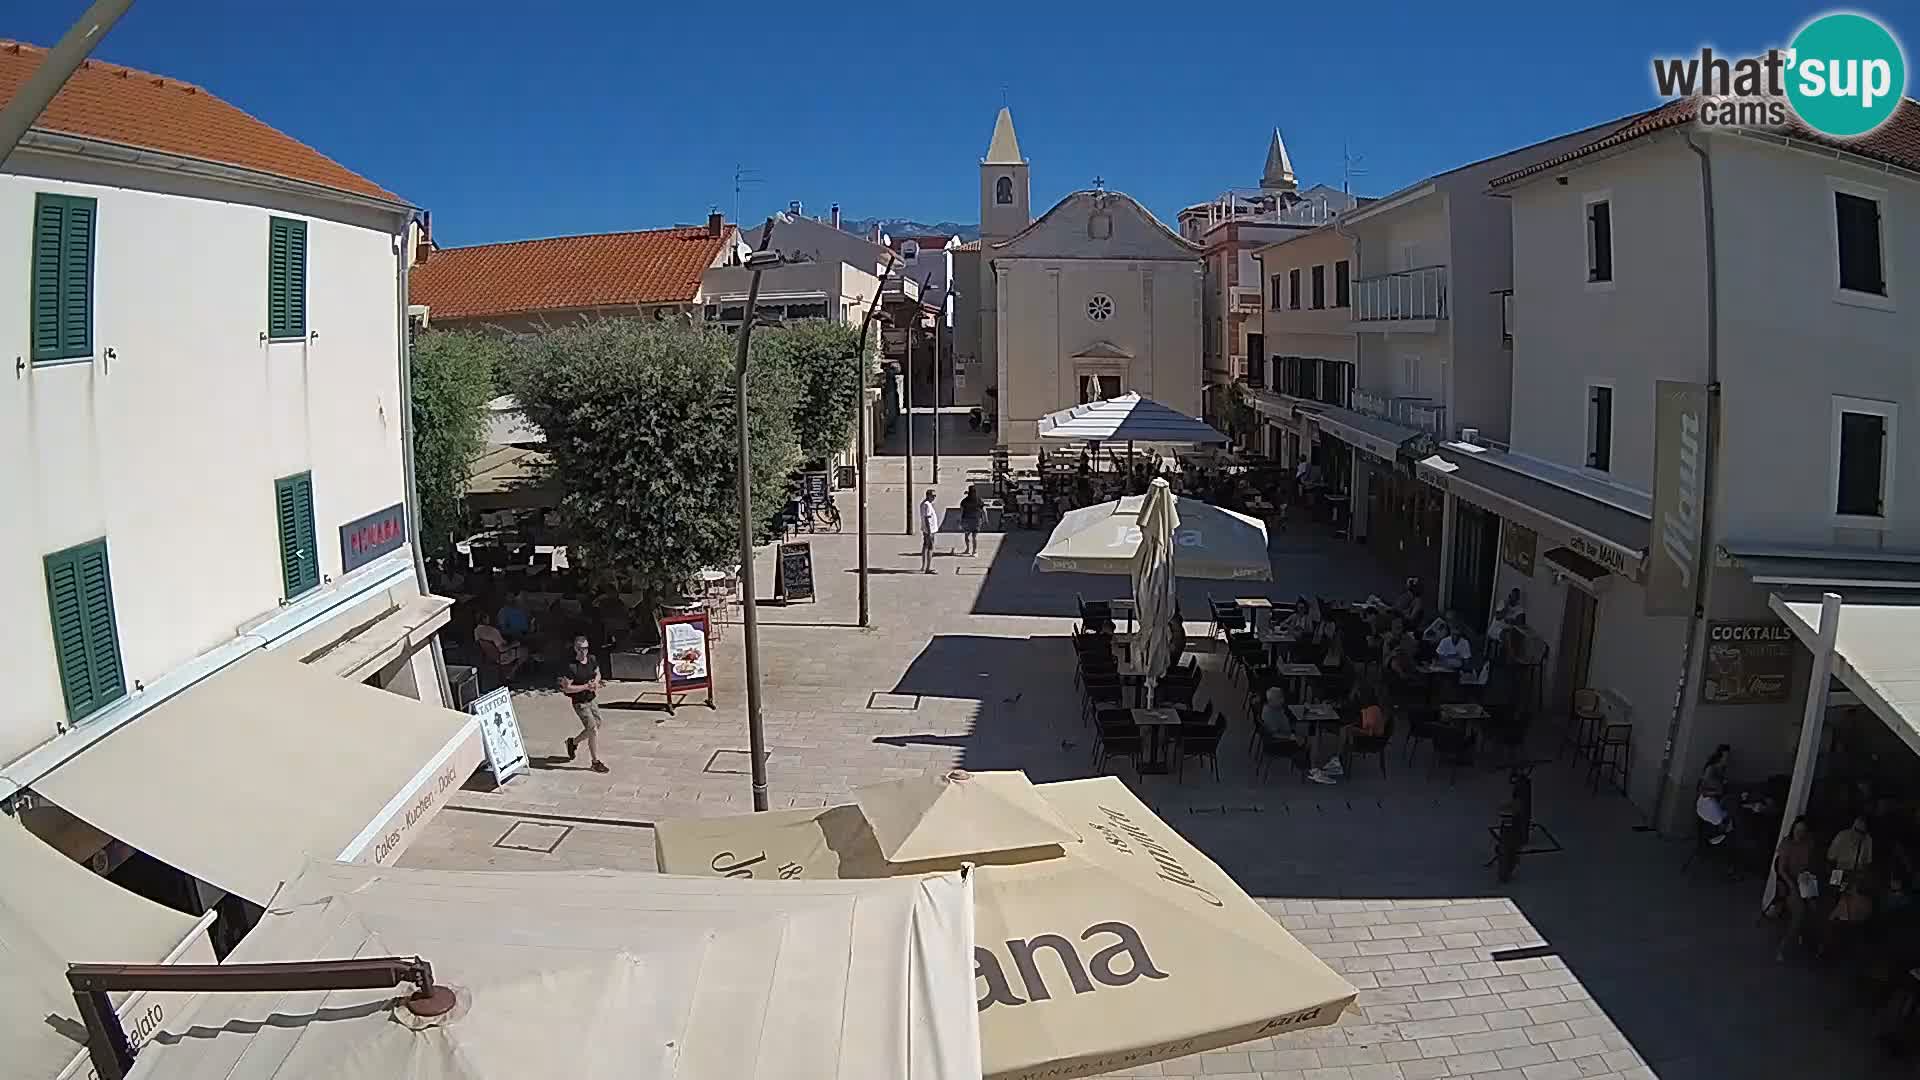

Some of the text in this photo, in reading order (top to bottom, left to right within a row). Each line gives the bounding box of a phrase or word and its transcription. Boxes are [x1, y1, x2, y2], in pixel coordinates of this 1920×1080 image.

[1711, 626, 1792, 641] COCKTAILS
[478, 694, 508, 716] TATTOO
[374, 827, 401, 865] Cakes
[405, 792, 435, 830] Kuchen
[974, 921, 1170, 1013] ana
[126, 1003, 165, 1051] elato
